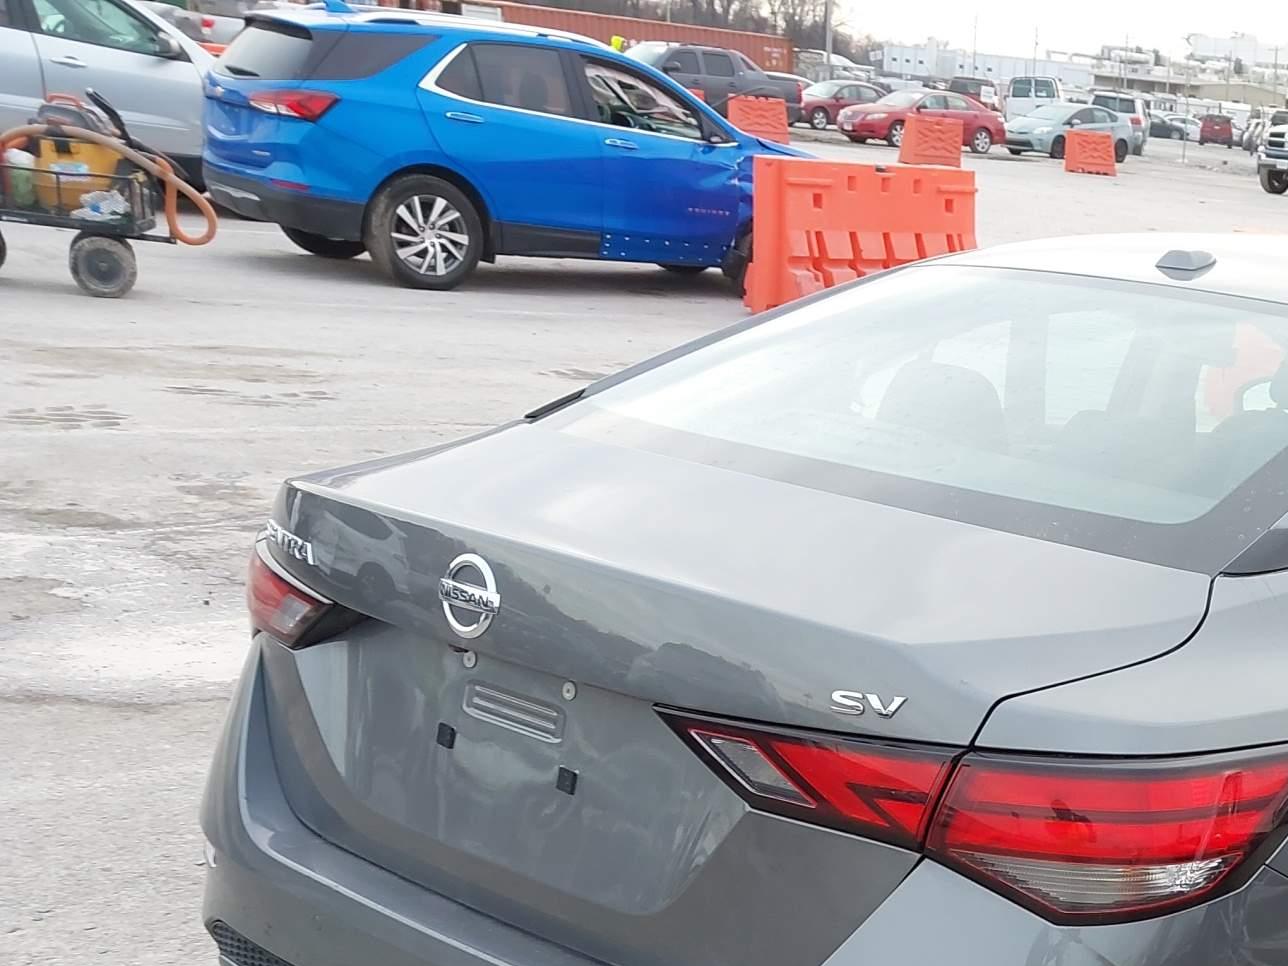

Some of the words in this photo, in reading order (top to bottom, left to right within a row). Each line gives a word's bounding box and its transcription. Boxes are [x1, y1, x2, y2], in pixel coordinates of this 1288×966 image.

[265, 519, 315, 566] NTRA
[440, 580, 490, 611] NISSAN
[830, 689, 909, 719] SV
